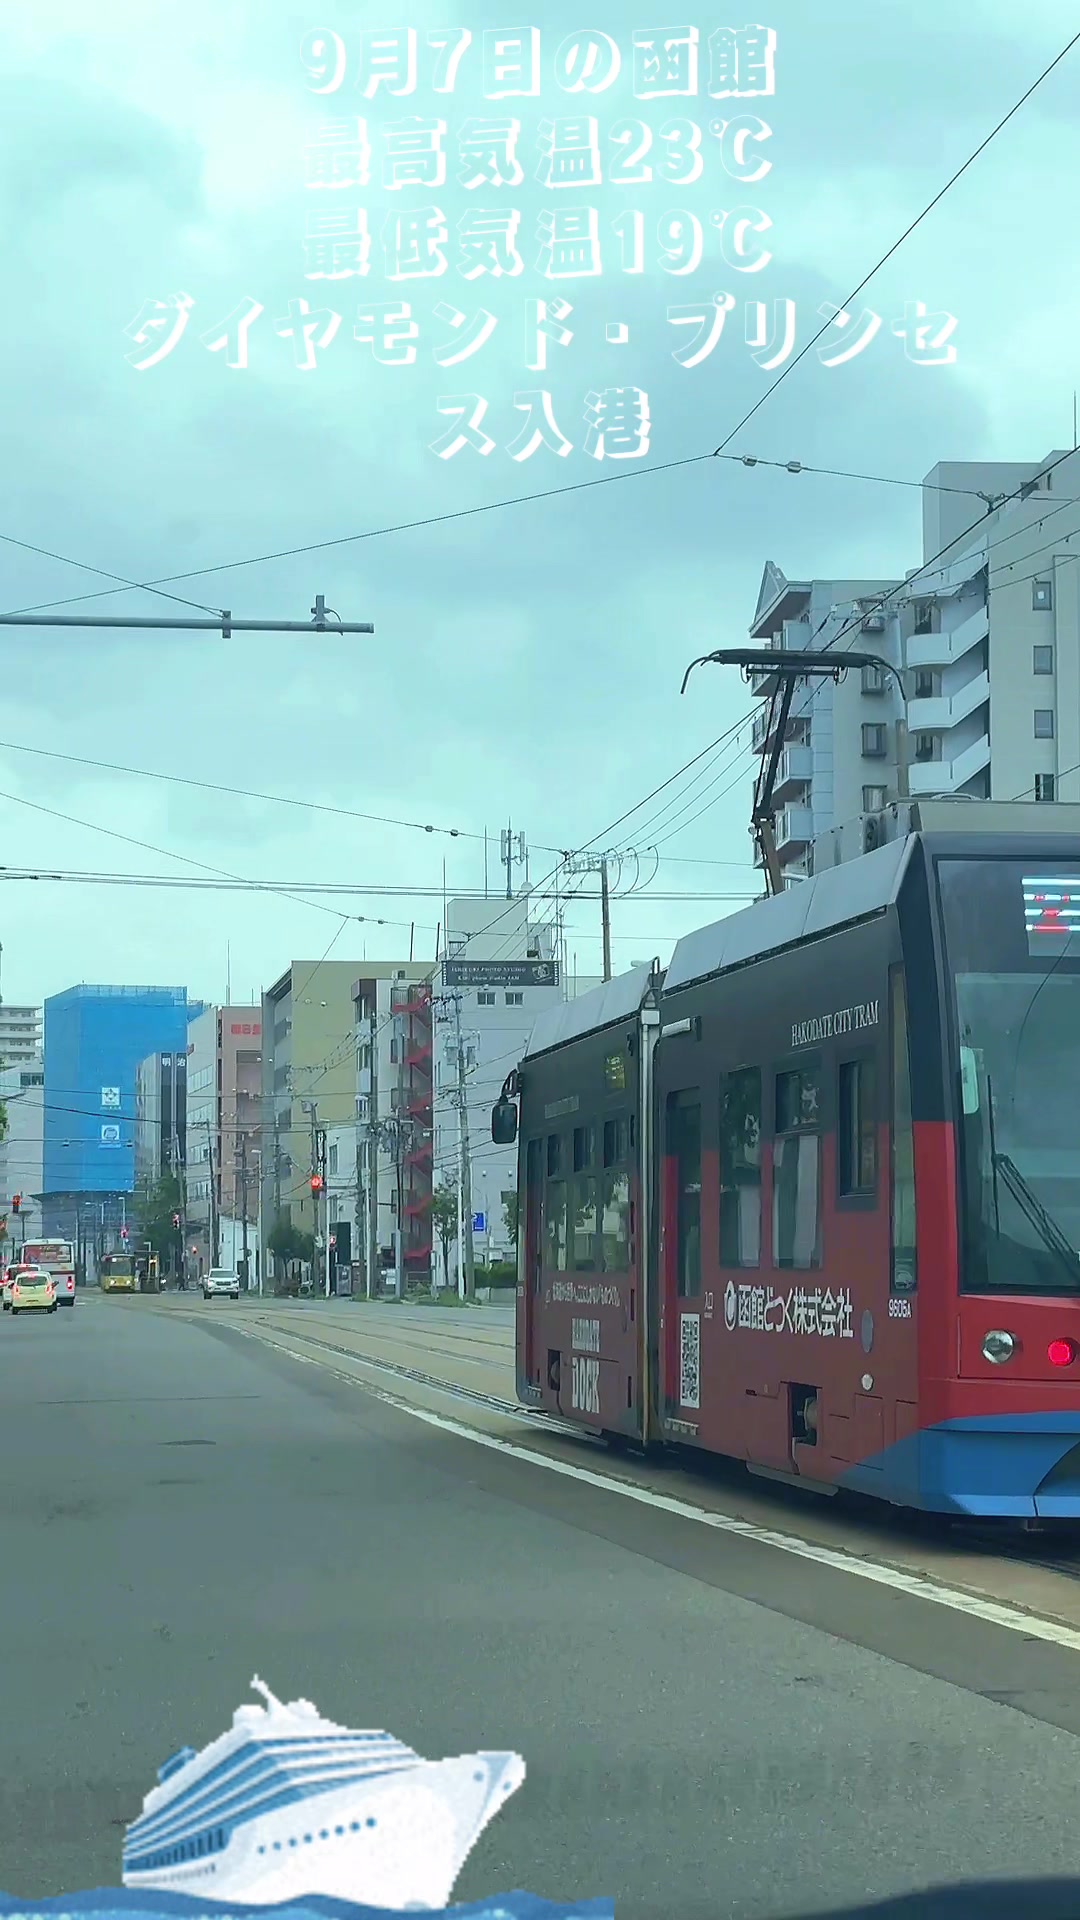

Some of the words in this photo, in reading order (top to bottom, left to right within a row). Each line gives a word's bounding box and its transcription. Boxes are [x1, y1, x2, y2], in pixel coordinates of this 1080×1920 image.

[791, 1014, 833, 1047] HAKODATE
[833, 1008, 853, 1035] CITY
[853, 999, 879, 1030] TRAM
[572, 1356, 600, 1414] DOCK
